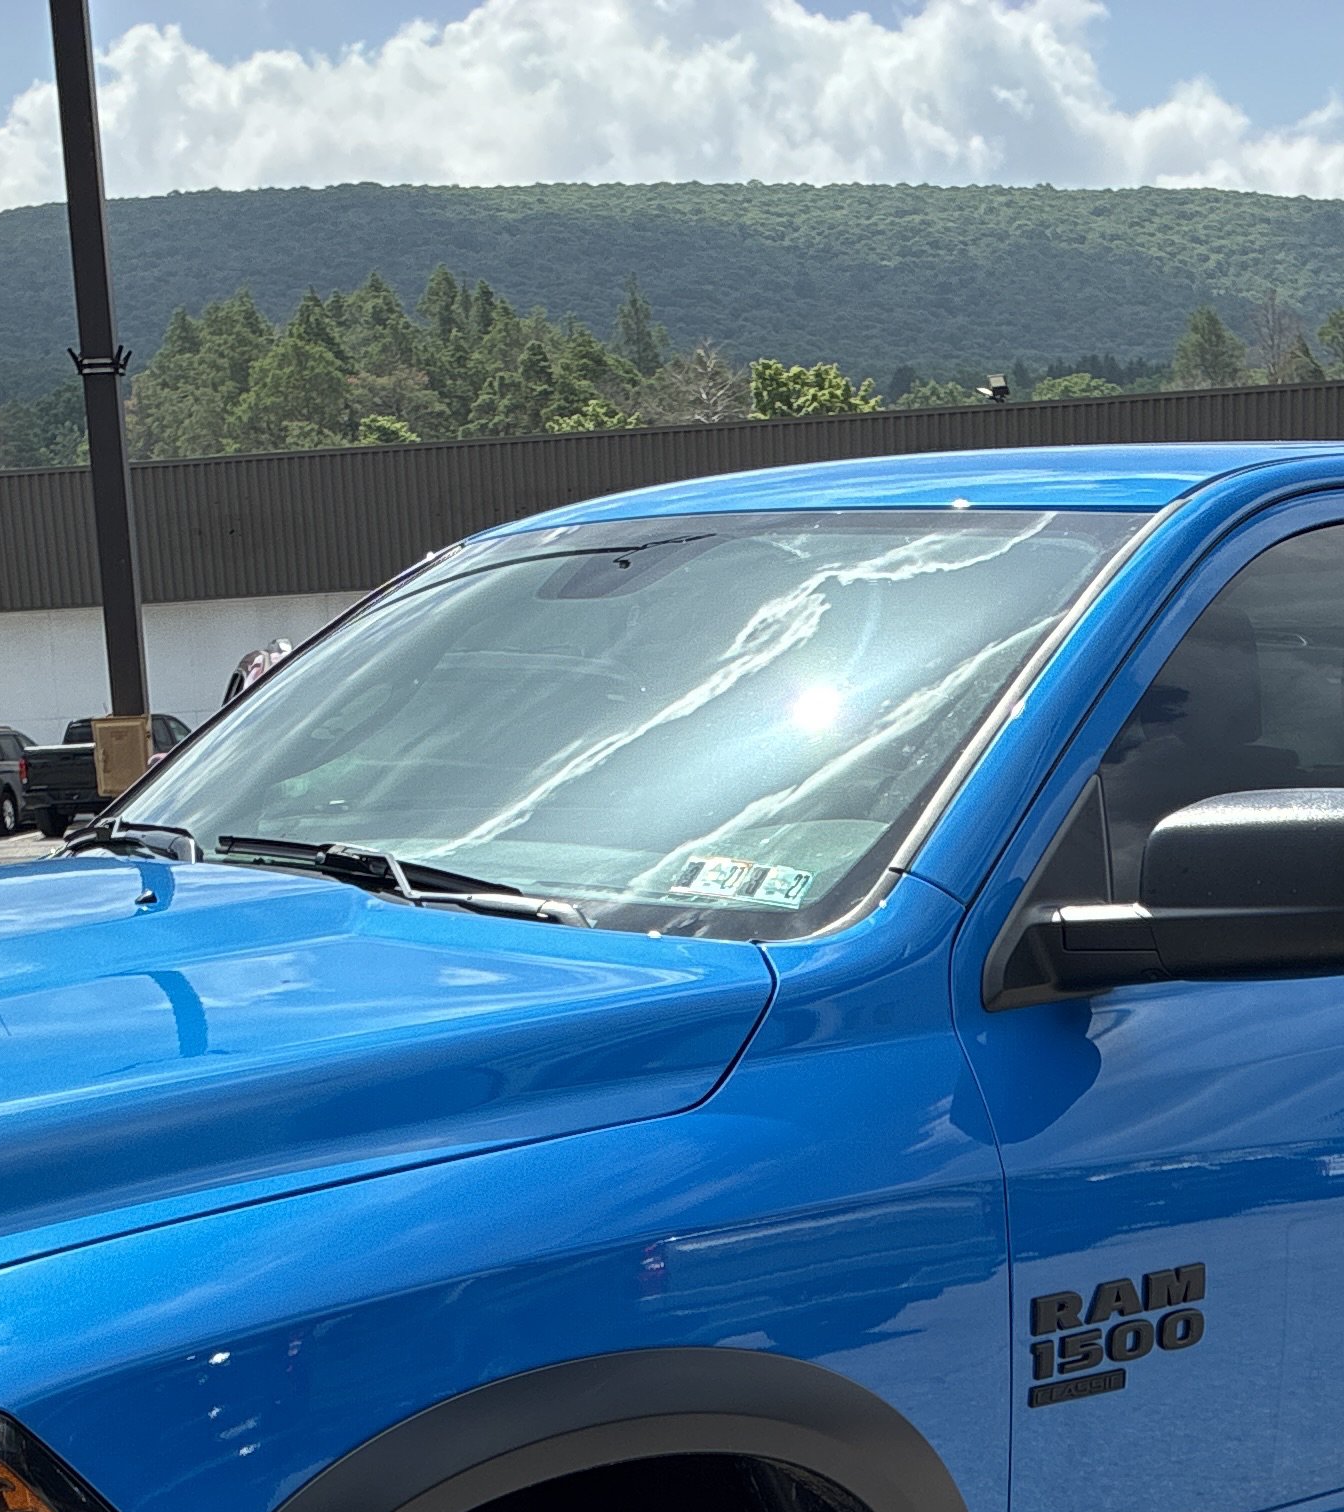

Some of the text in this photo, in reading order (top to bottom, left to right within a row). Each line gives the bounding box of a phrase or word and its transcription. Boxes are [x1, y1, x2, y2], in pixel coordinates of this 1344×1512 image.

[1030, 1262, 1206, 1337] RAM
[1030, 1308, 1205, 1380] 1500
[1033, 1373, 1121, 1406] CLASSIC
